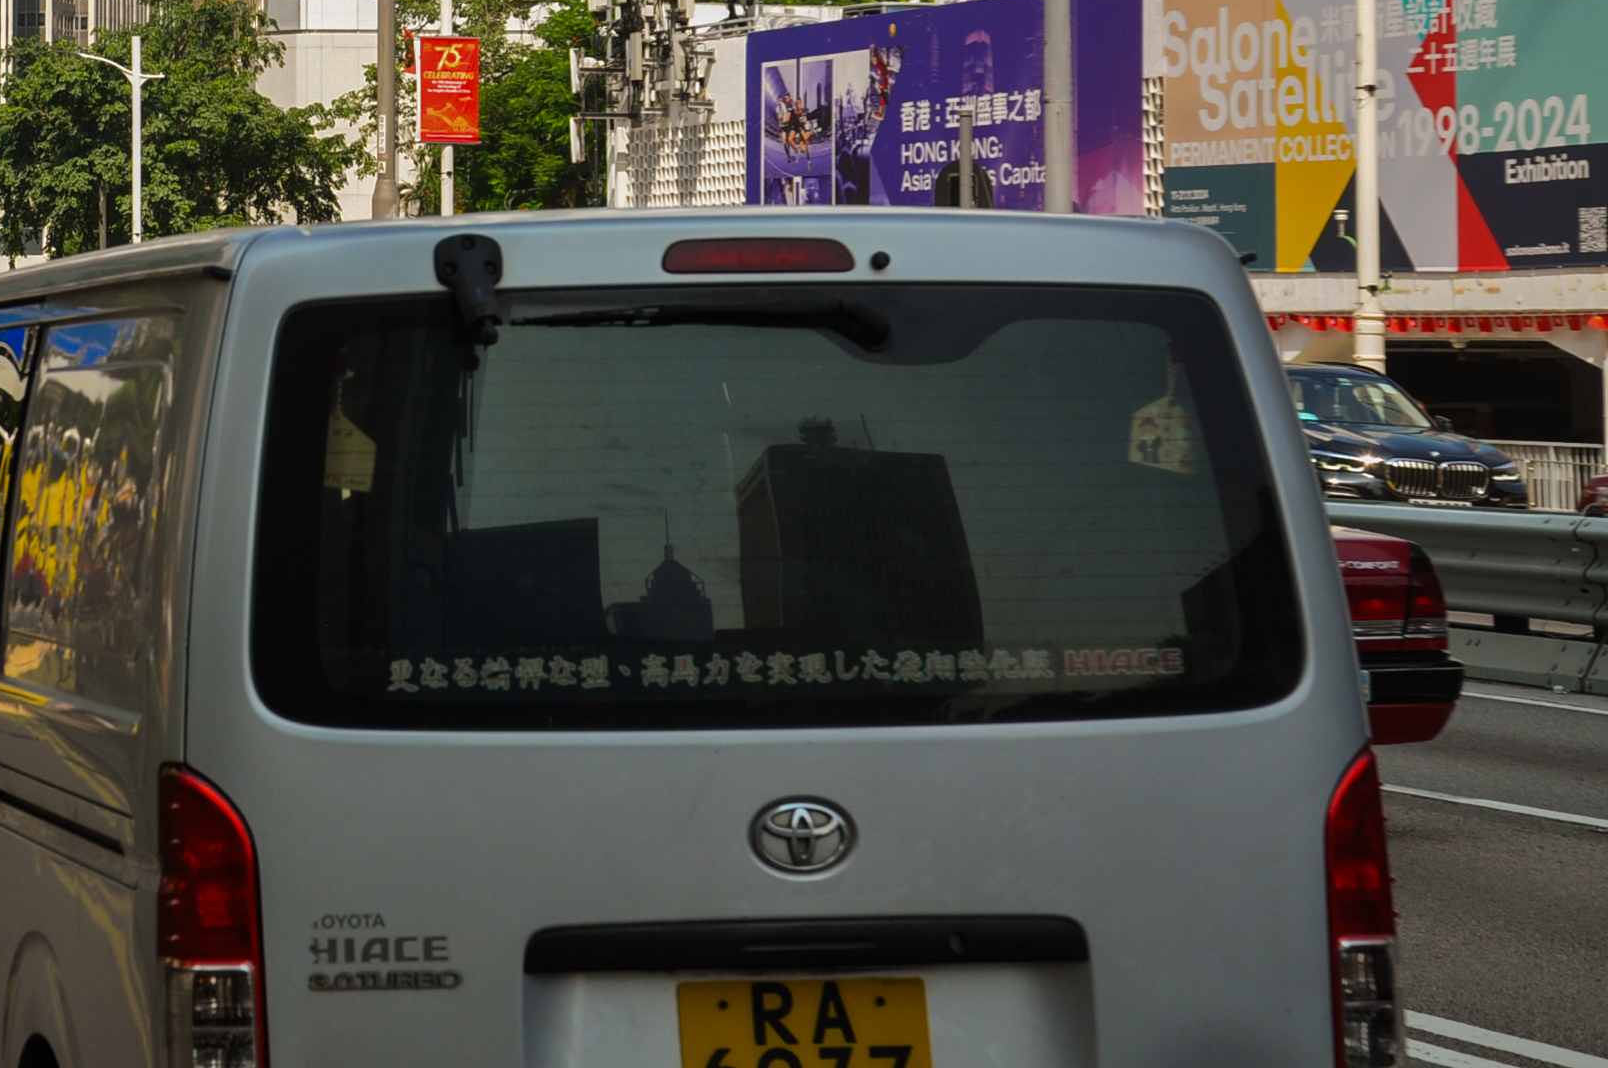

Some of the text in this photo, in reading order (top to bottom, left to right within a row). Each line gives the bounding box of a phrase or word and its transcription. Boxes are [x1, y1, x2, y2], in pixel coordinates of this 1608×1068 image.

[434, 44, 463, 70] 75
[1164, 7, 1317, 78] Salone
[1406, 35, 1516, 74] 二十五週年展
[423, 71, 474, 80] CELEBRATING
[1398, 94, 1591, 157] 1998-2024
[901, 136, 1003, 164] HONG KNG:
[1171, 133, 1396, 167] PERMANENT COLLECTN
[1000, 160, 1046, 189] Capita
[1505, 153, 1590, 184] Exhibition
[1063, 648, 1185, 676] HIACE
[309, 936, 448, 964] HIACE
[751, 980, 858, 1046] RA
